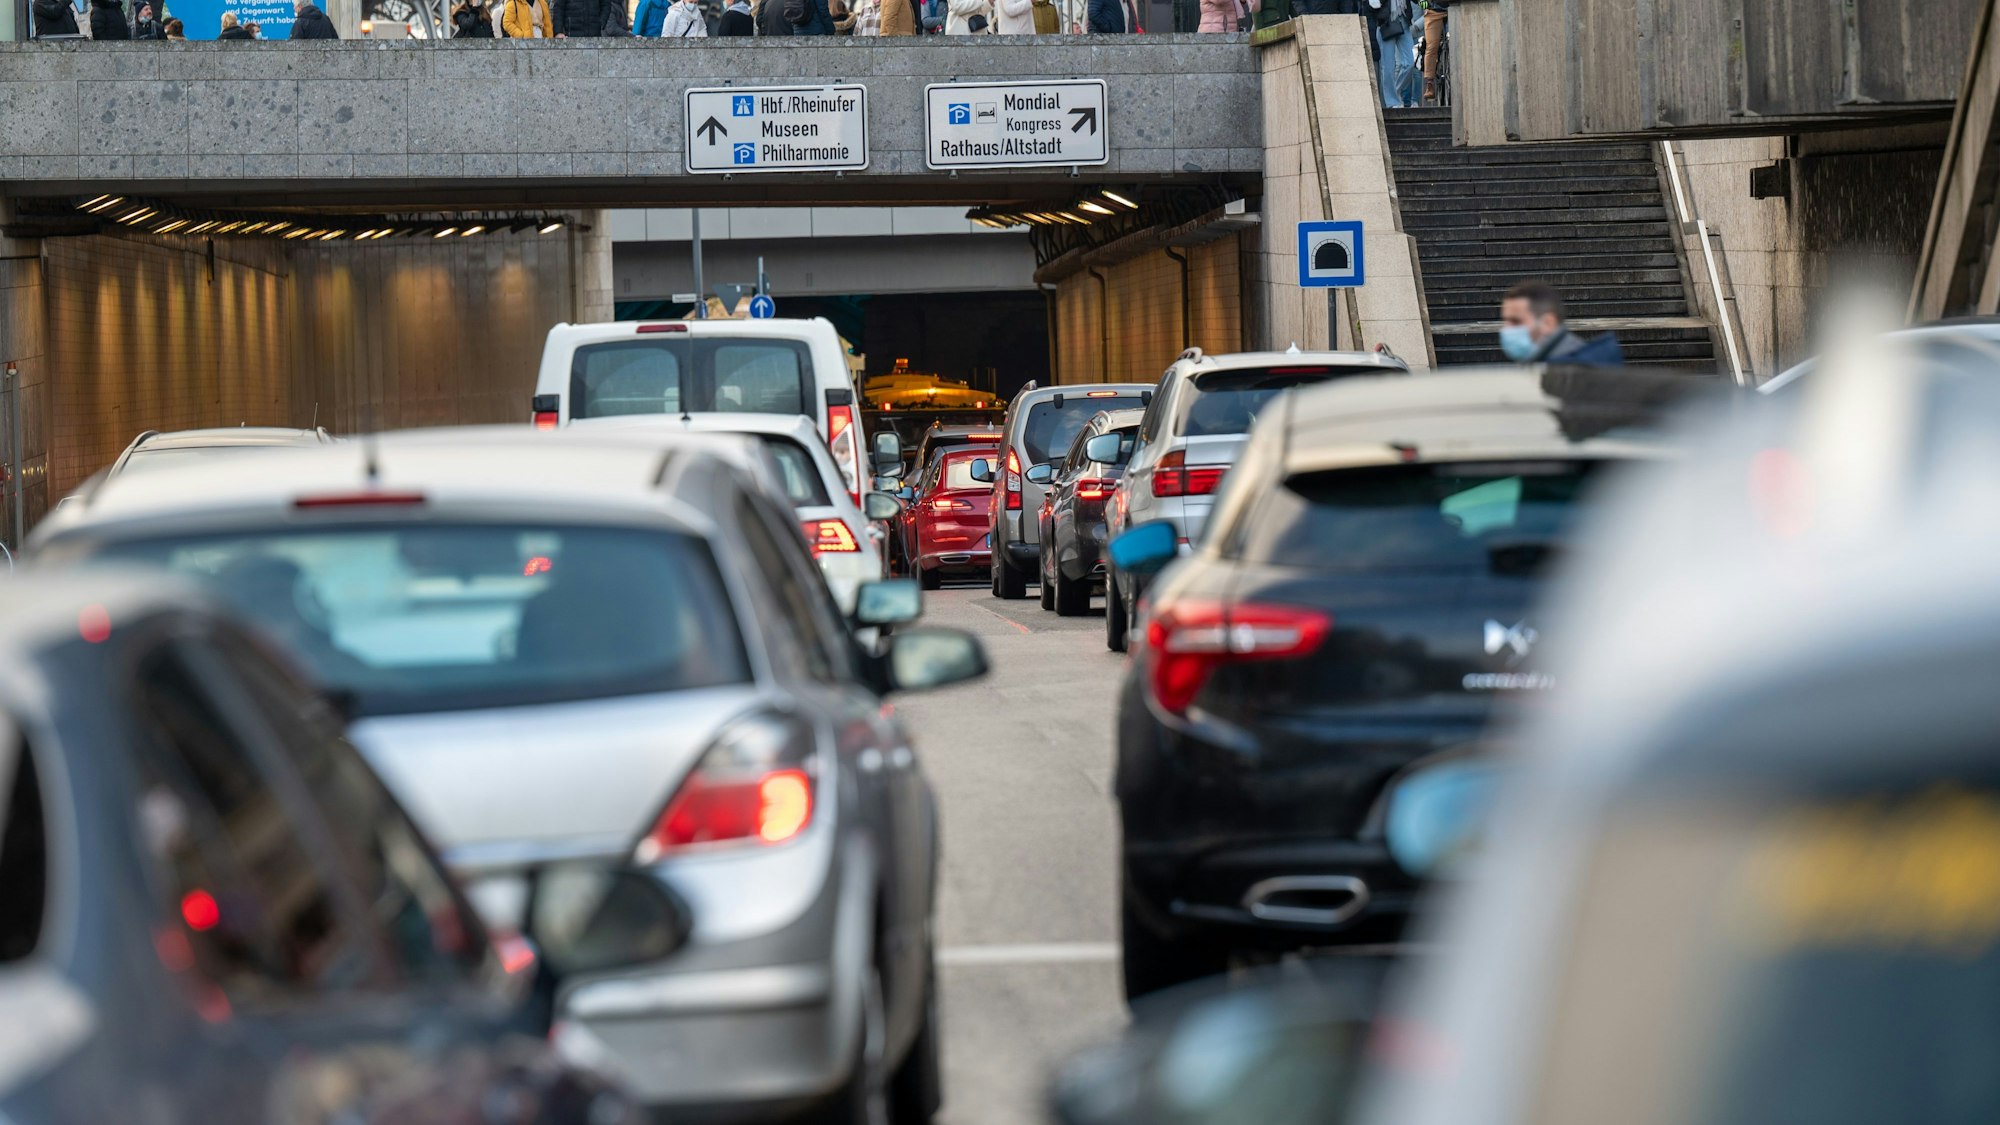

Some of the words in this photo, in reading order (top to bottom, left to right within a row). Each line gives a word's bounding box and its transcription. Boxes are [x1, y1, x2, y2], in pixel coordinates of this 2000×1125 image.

[242, 7, 285, 16] Gegenwart
[276, 16, 297, 24] habe
[761, 95, 856, 114] Hbf./Rheinufer
[1004, 92, 1061, 111] Mondial
[762, 121, 818, 138] Museen
[1006, 118, 1061, 134] Kongress
[763, 143, 849, 162] Philharmonie
[941, 137, 1062, 157] Rathaus/Altstadt
